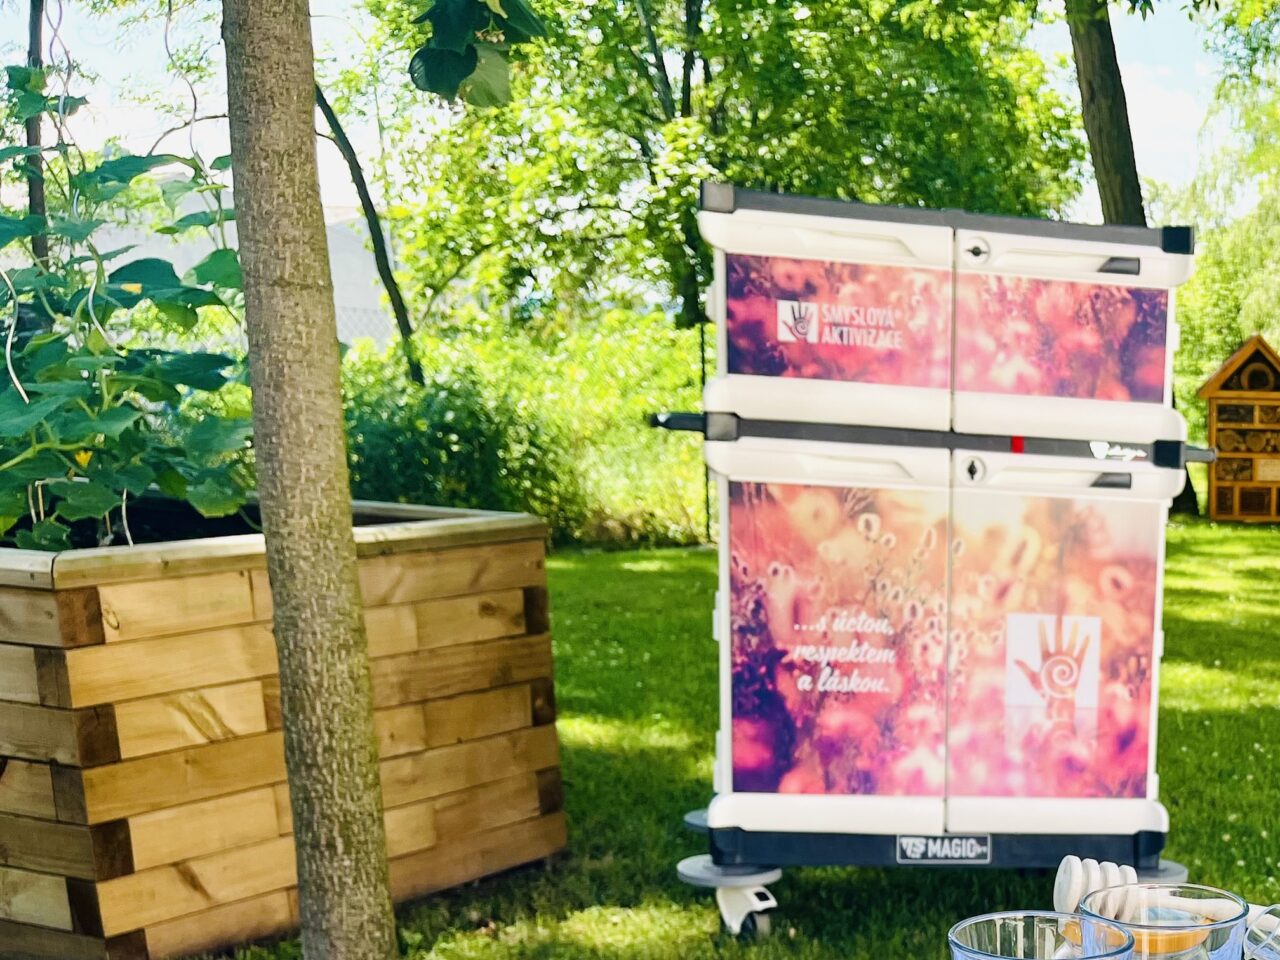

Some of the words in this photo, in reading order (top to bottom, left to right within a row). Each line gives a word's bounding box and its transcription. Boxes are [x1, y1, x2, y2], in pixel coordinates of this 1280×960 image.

[821, 324, 902, 349] AKTIVIZACE
[793, 639, 896, 669] respektem
[797, 674, 813, 692] a
[818, 665, 889, 693] láskou.
[927, 838, 977, 858] MAGIC
